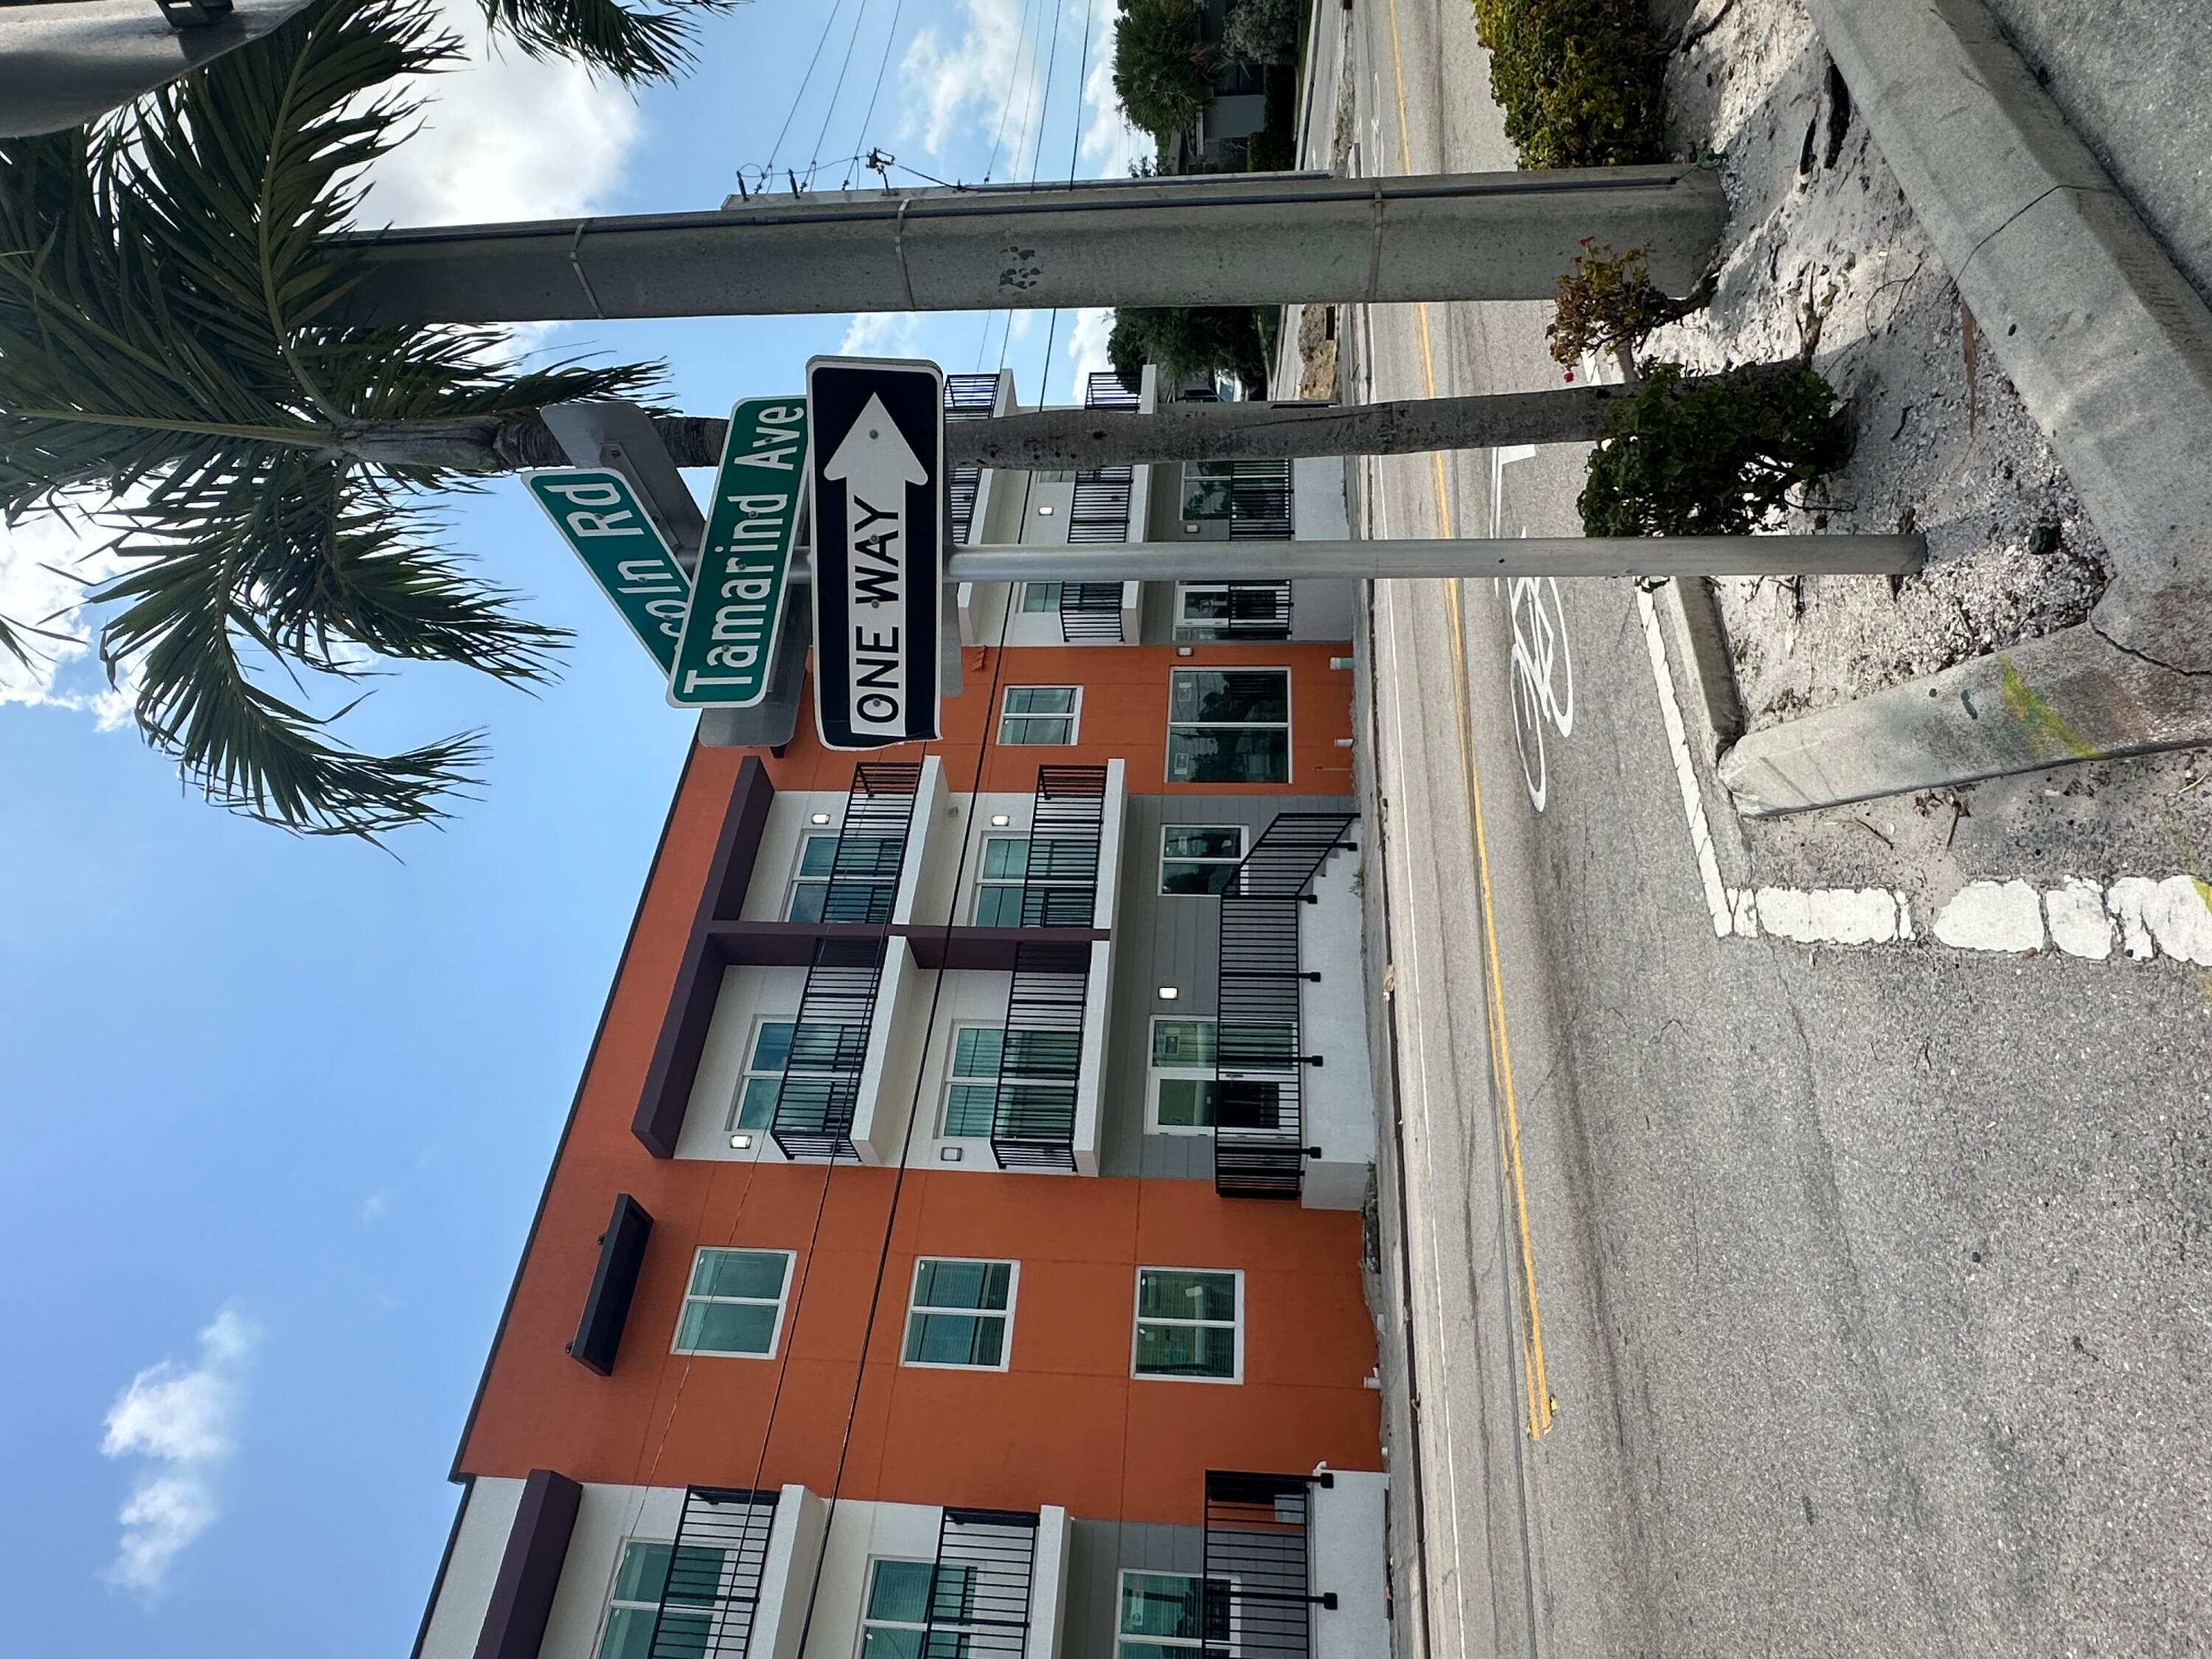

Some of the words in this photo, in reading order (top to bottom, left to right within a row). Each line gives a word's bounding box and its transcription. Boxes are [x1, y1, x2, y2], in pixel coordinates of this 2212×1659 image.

[734, 406, 804, 470] Ave
[543, 483, 644, 537] Rd
[854, 494, 899, 605] WAY
[683, 493, 788, 693] Tamarind
[855, 625, 900, 723] ONE
